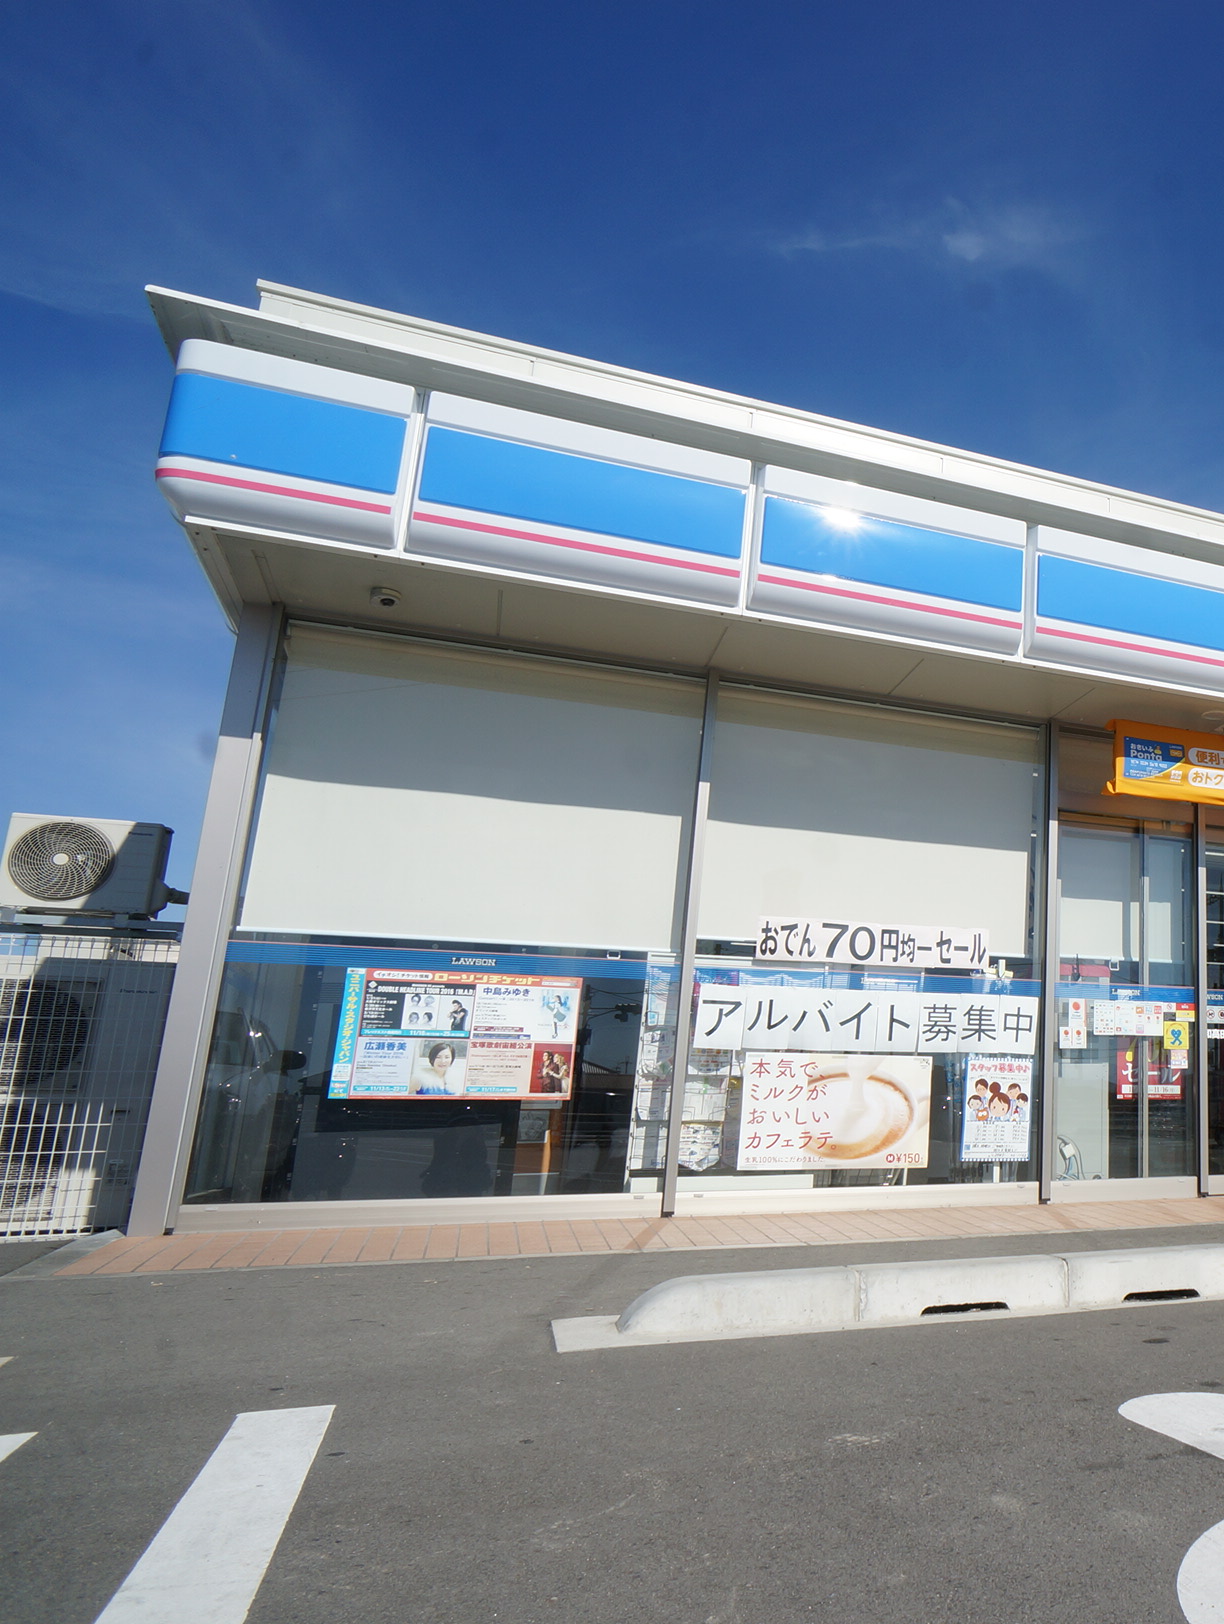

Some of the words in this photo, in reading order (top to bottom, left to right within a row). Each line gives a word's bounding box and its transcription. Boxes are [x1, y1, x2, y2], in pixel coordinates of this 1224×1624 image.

[1130, 750, 1163, 762] Ponta
[759, 920, 987, 965] おでん70円均一セール
[452, 957, 496, 966] LAWSON
[434, 972, 541, 985] ローソンチケット
[378, 985, 399, 993] DOUBLE
[399, 986, 426, 994] HEADLINE
[483, 987, 531, 997] 中島みゆき
[702, 998, 1034, 1044] アルバイト募集中
[750, 1058, 826, 1079] 本気で、
[750, 1084, 828, 1102] ミルクが
[747, 1107, 830, 1125] おいしい
[745, 1131, 837, 1151] カフェラテ。
